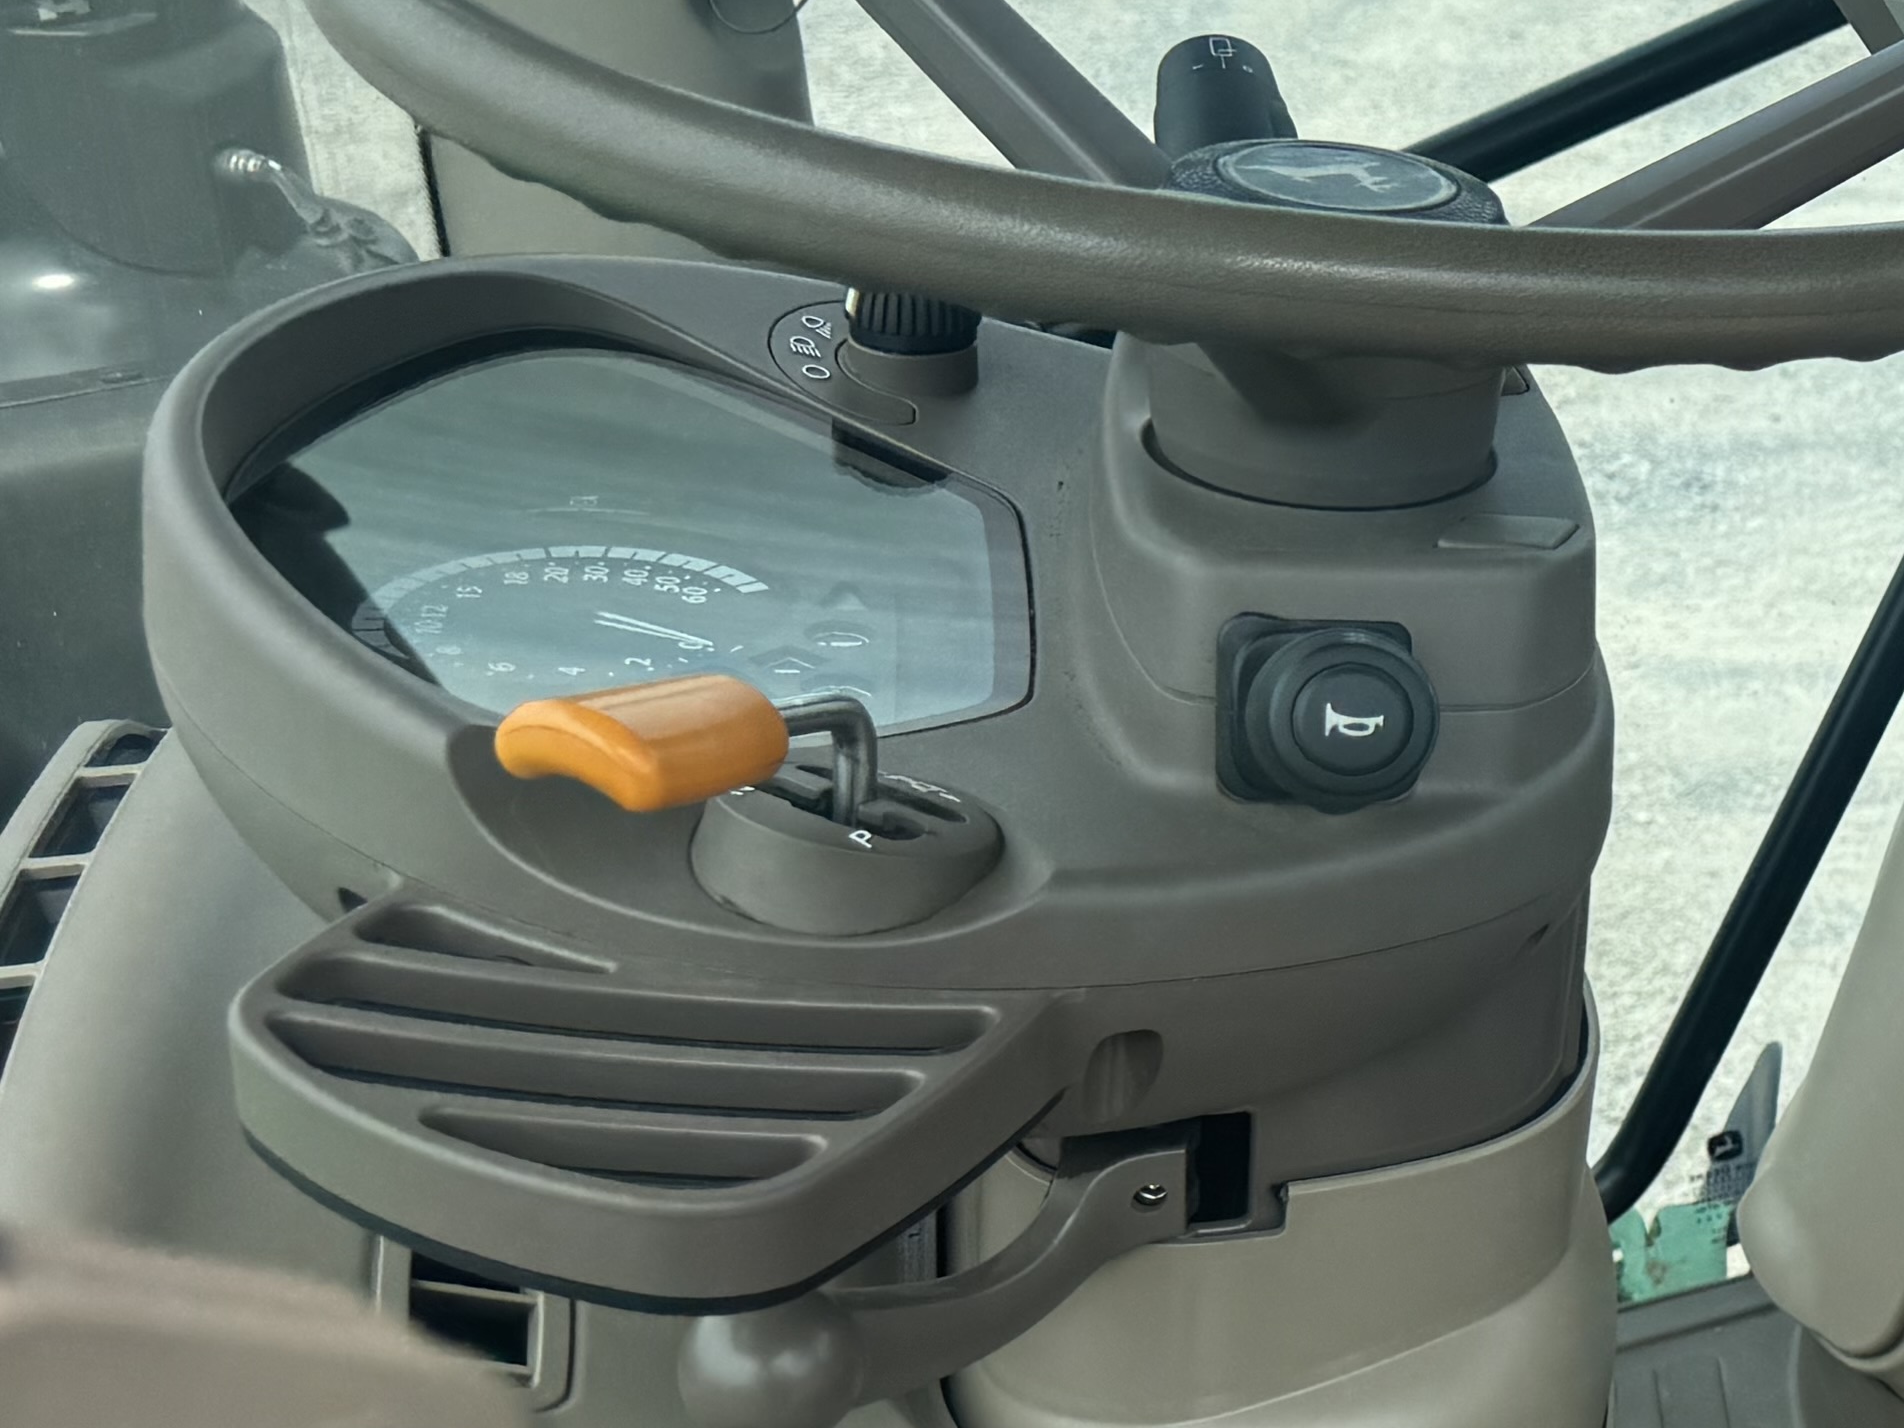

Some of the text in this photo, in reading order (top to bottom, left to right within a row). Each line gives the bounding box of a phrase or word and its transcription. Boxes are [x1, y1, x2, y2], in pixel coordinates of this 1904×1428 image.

[503, 571, 530, 585] 18
[543, 566, 569, 584] 20
[582, 565, 610, 583] 30
[622, 569, 649, 586] 40
[456, 585, 483, 598] 15
[653, 576, 681, 593] 50
[681, 586, 708, 604] 60
[421, 604, 448, 618] 12
[488, 662, 516, 672] 6
[624, 657, 652, 666] 2
[558, 667, 586, 676] 4
[849, 829, 873, 849] P
